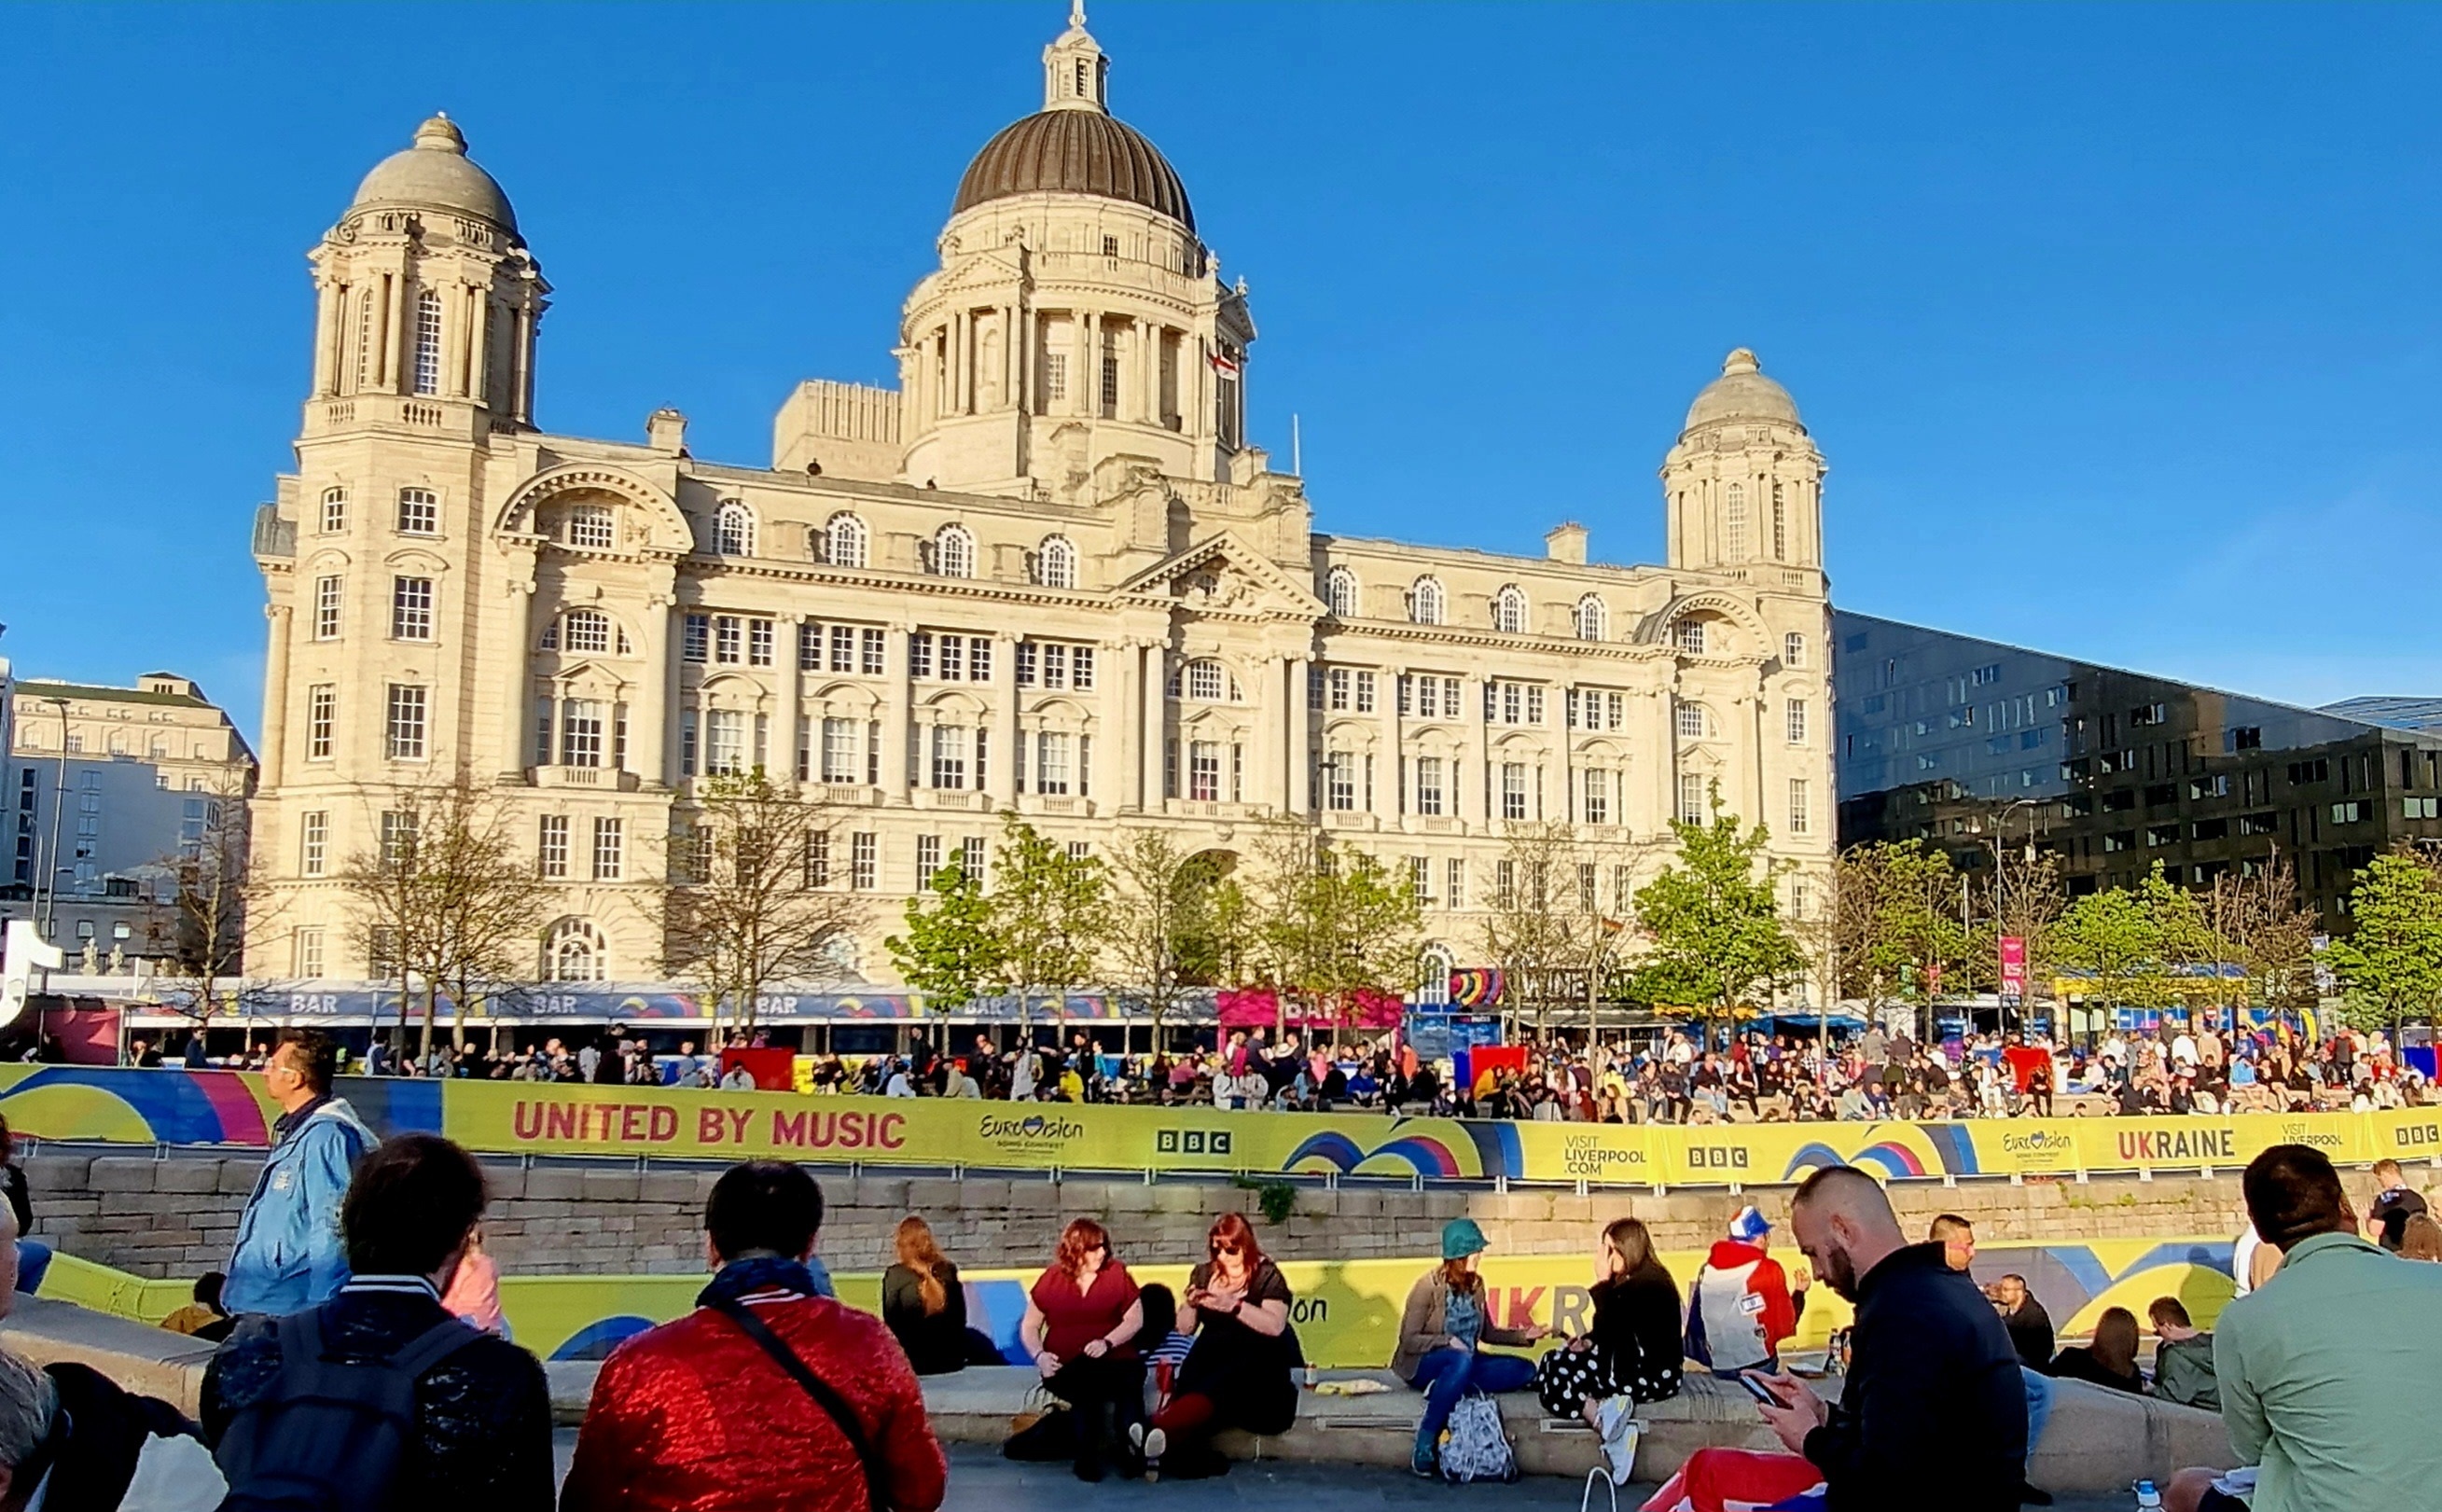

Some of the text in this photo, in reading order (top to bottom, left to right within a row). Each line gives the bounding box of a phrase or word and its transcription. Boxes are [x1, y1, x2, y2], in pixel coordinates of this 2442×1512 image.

[290, 992, 337, 1014] BAR
[533, 994, 577, 1014] BAR
[756, 995, 797, 1014] BAR
[964, 997, 1004, 1015] BAR
[514, 1101, 906, 1148] UNITED BY MUSIC
[2282, 1123, 2306, 1135] VISIT
[1158, 1130, 1230, 1153] BBC
[1565, 1135, 1600, 1149] VISIT
[2118, 1130, 2235, 1160] UKRAINE
[2396, 1125, 2439, 1145] BBC
[1564, 1149, 1646, 1163] LIVERPOOL
[1689, 1147, 1748, 1167] BBC
[1563, 1162, 1602, 1175] .COM
